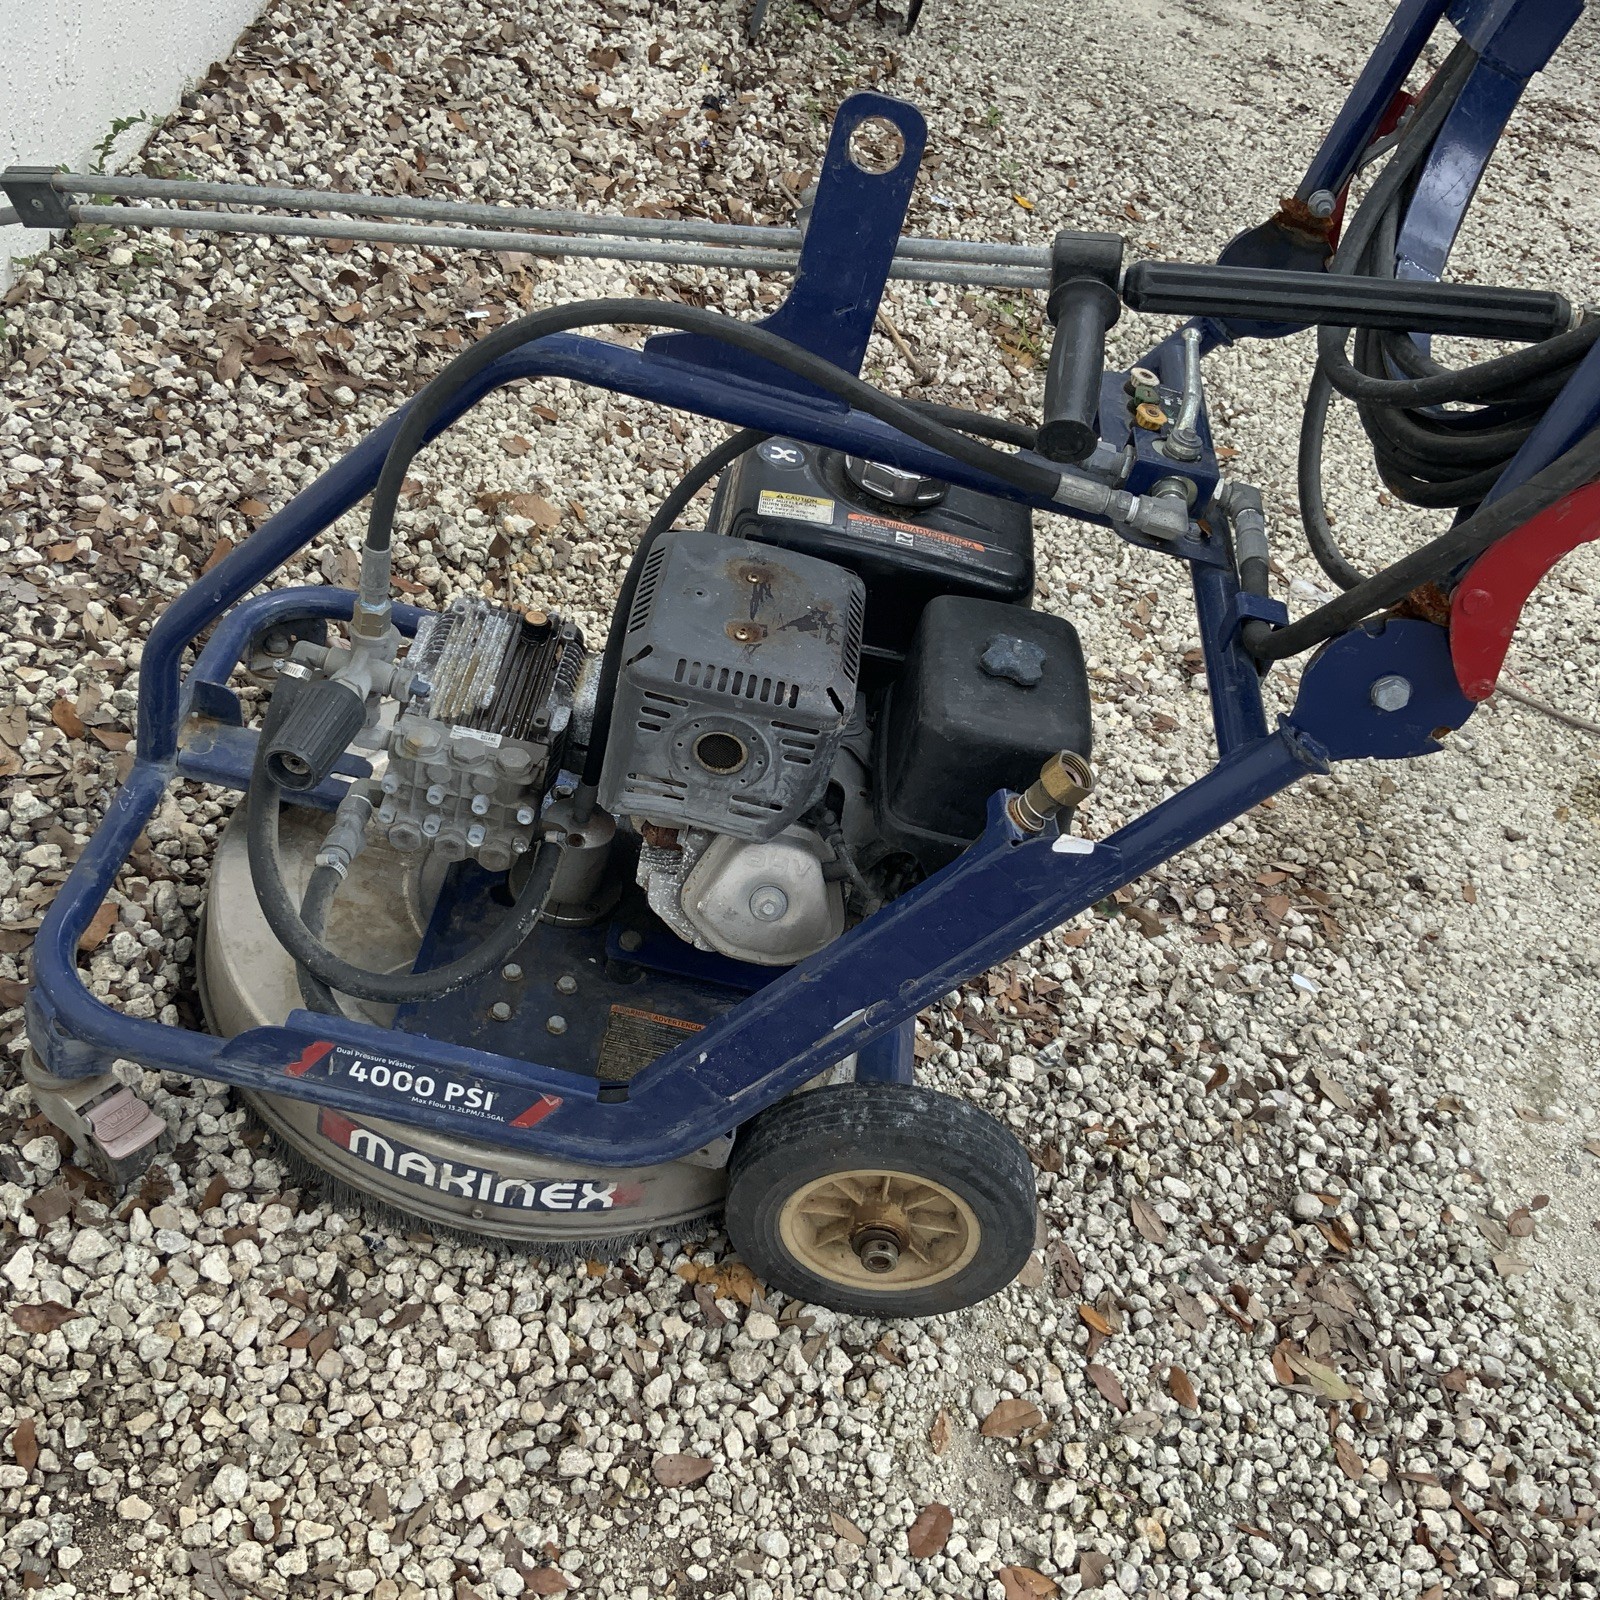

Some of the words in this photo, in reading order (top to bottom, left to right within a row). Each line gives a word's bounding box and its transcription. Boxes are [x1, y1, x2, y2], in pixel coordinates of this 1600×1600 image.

[785, 495, 818, 503] CAUTION
[864, 516, 976, 549] WARNING/ADVERTENCIA
[336, 1047, 353, 1056] Dual
[355, 1050, 387, 1064] Pressure
[388, 1058, 416, 1070] Washer
[348, 1060, 436, 1097] 4000
[444, 1082, 494, 1111] PSI
[411, 1096, 427, 1105] Max
[428, 1099, 446, 1110] Flow
[448, 1104, 506, 1123] 13.2LPM/3.5GAL
[349, 1128, 618, 1210] MAKINEX
